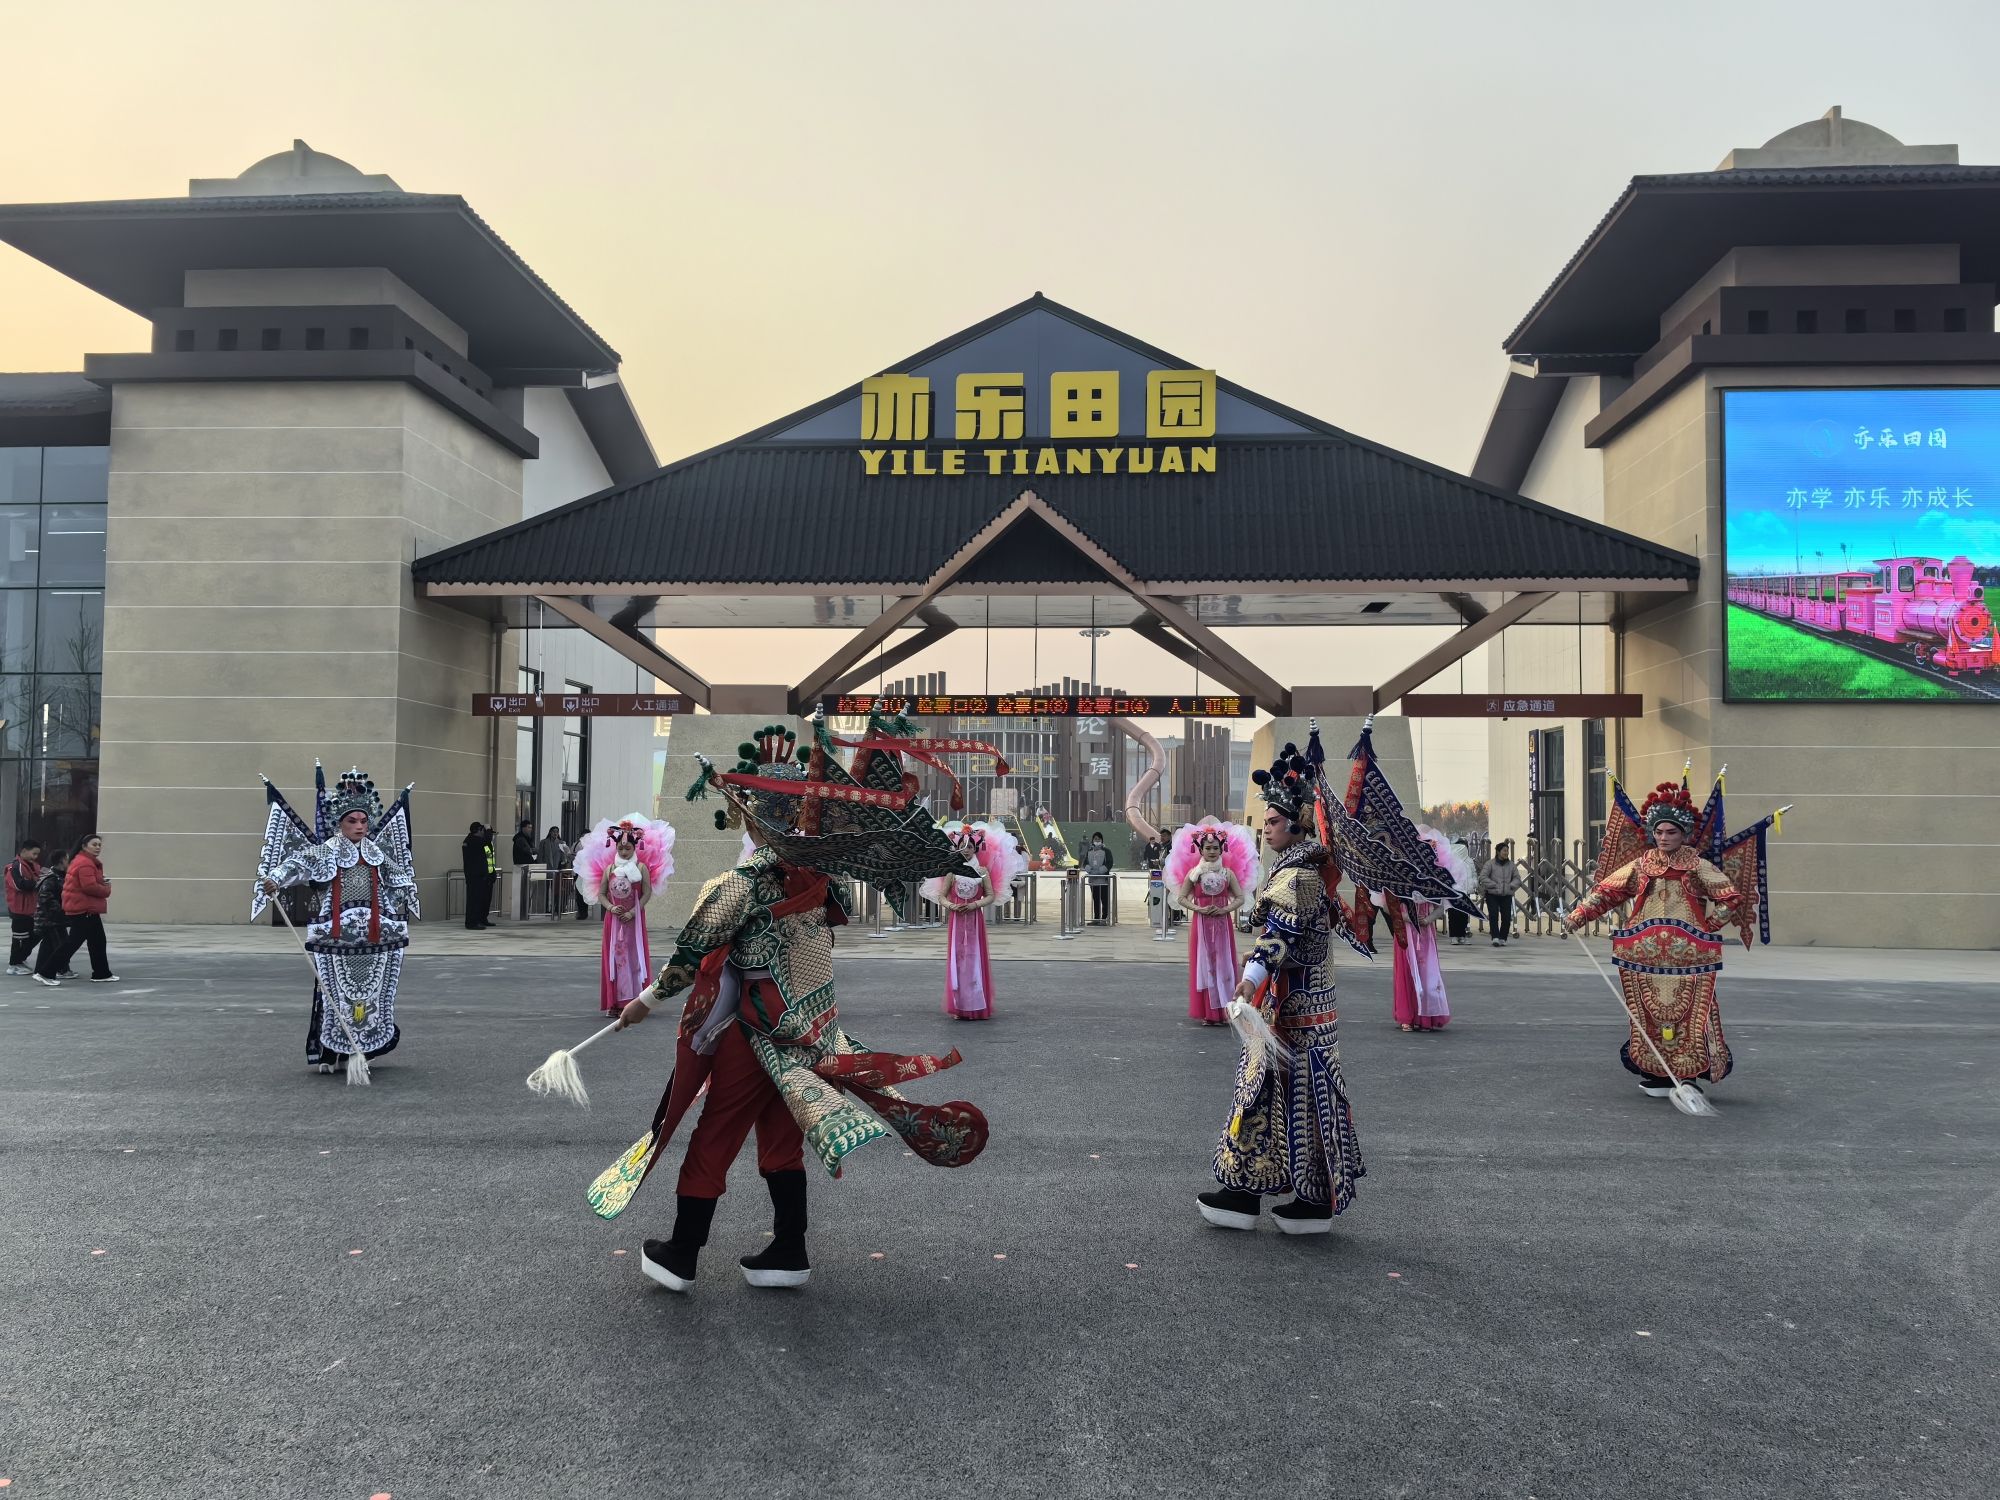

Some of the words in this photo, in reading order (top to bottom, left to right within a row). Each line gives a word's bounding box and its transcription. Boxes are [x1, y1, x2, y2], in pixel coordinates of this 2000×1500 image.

[861, 369, 1216, 440] 亦乐田园
[1853, 425, 1947, 449] 亦乐田园
[859, 448, 966, 475] YILE
[983, 446, 1216, 475] TIANYUAN
[1786, 486, 1833, 509] 亦学
[1844, 486, 1891, 509] 亦乐
[1902, 486, 1975, 509] 亦成长
[508, 697, 527, 707] 出口
[581, 697, 600, 707] 出口
[631, 699, 680, 711] 人工通道
[1503, 700, 1555, 712] 应急通道
